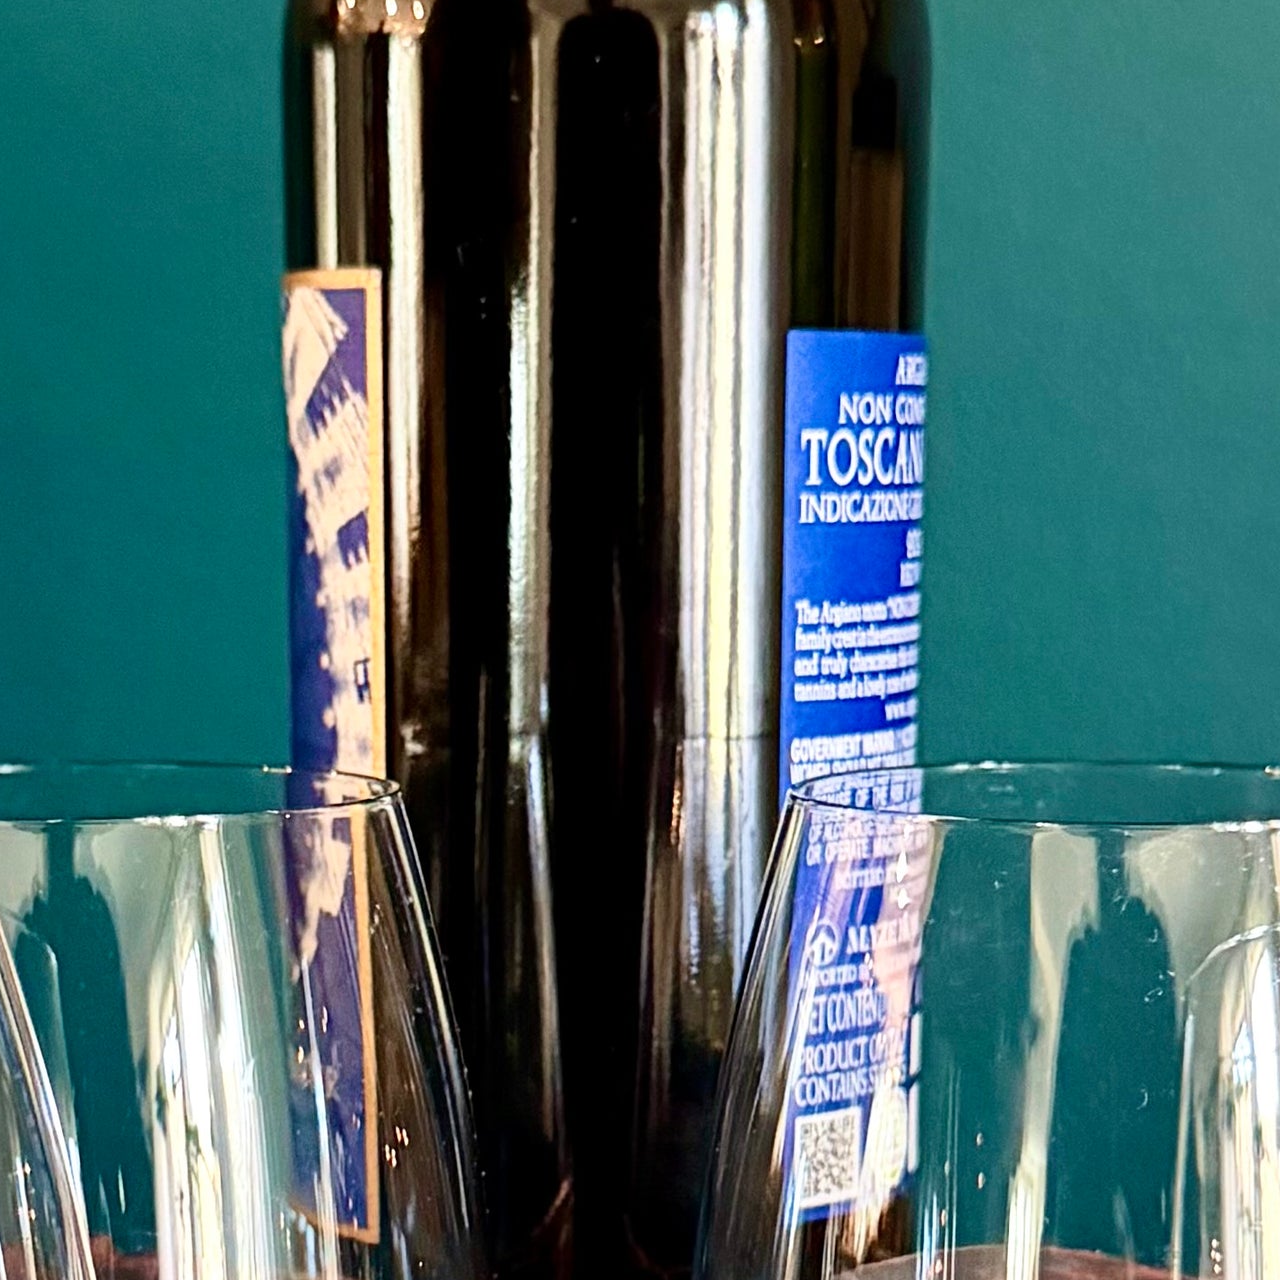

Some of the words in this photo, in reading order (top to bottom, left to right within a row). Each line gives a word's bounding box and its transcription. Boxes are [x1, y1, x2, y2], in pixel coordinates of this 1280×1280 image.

[839, 392, 893, 424] NON
[801, 427, 924, 487] TOSCAN
[794, 1066, 867, 1107] CONTAINS
